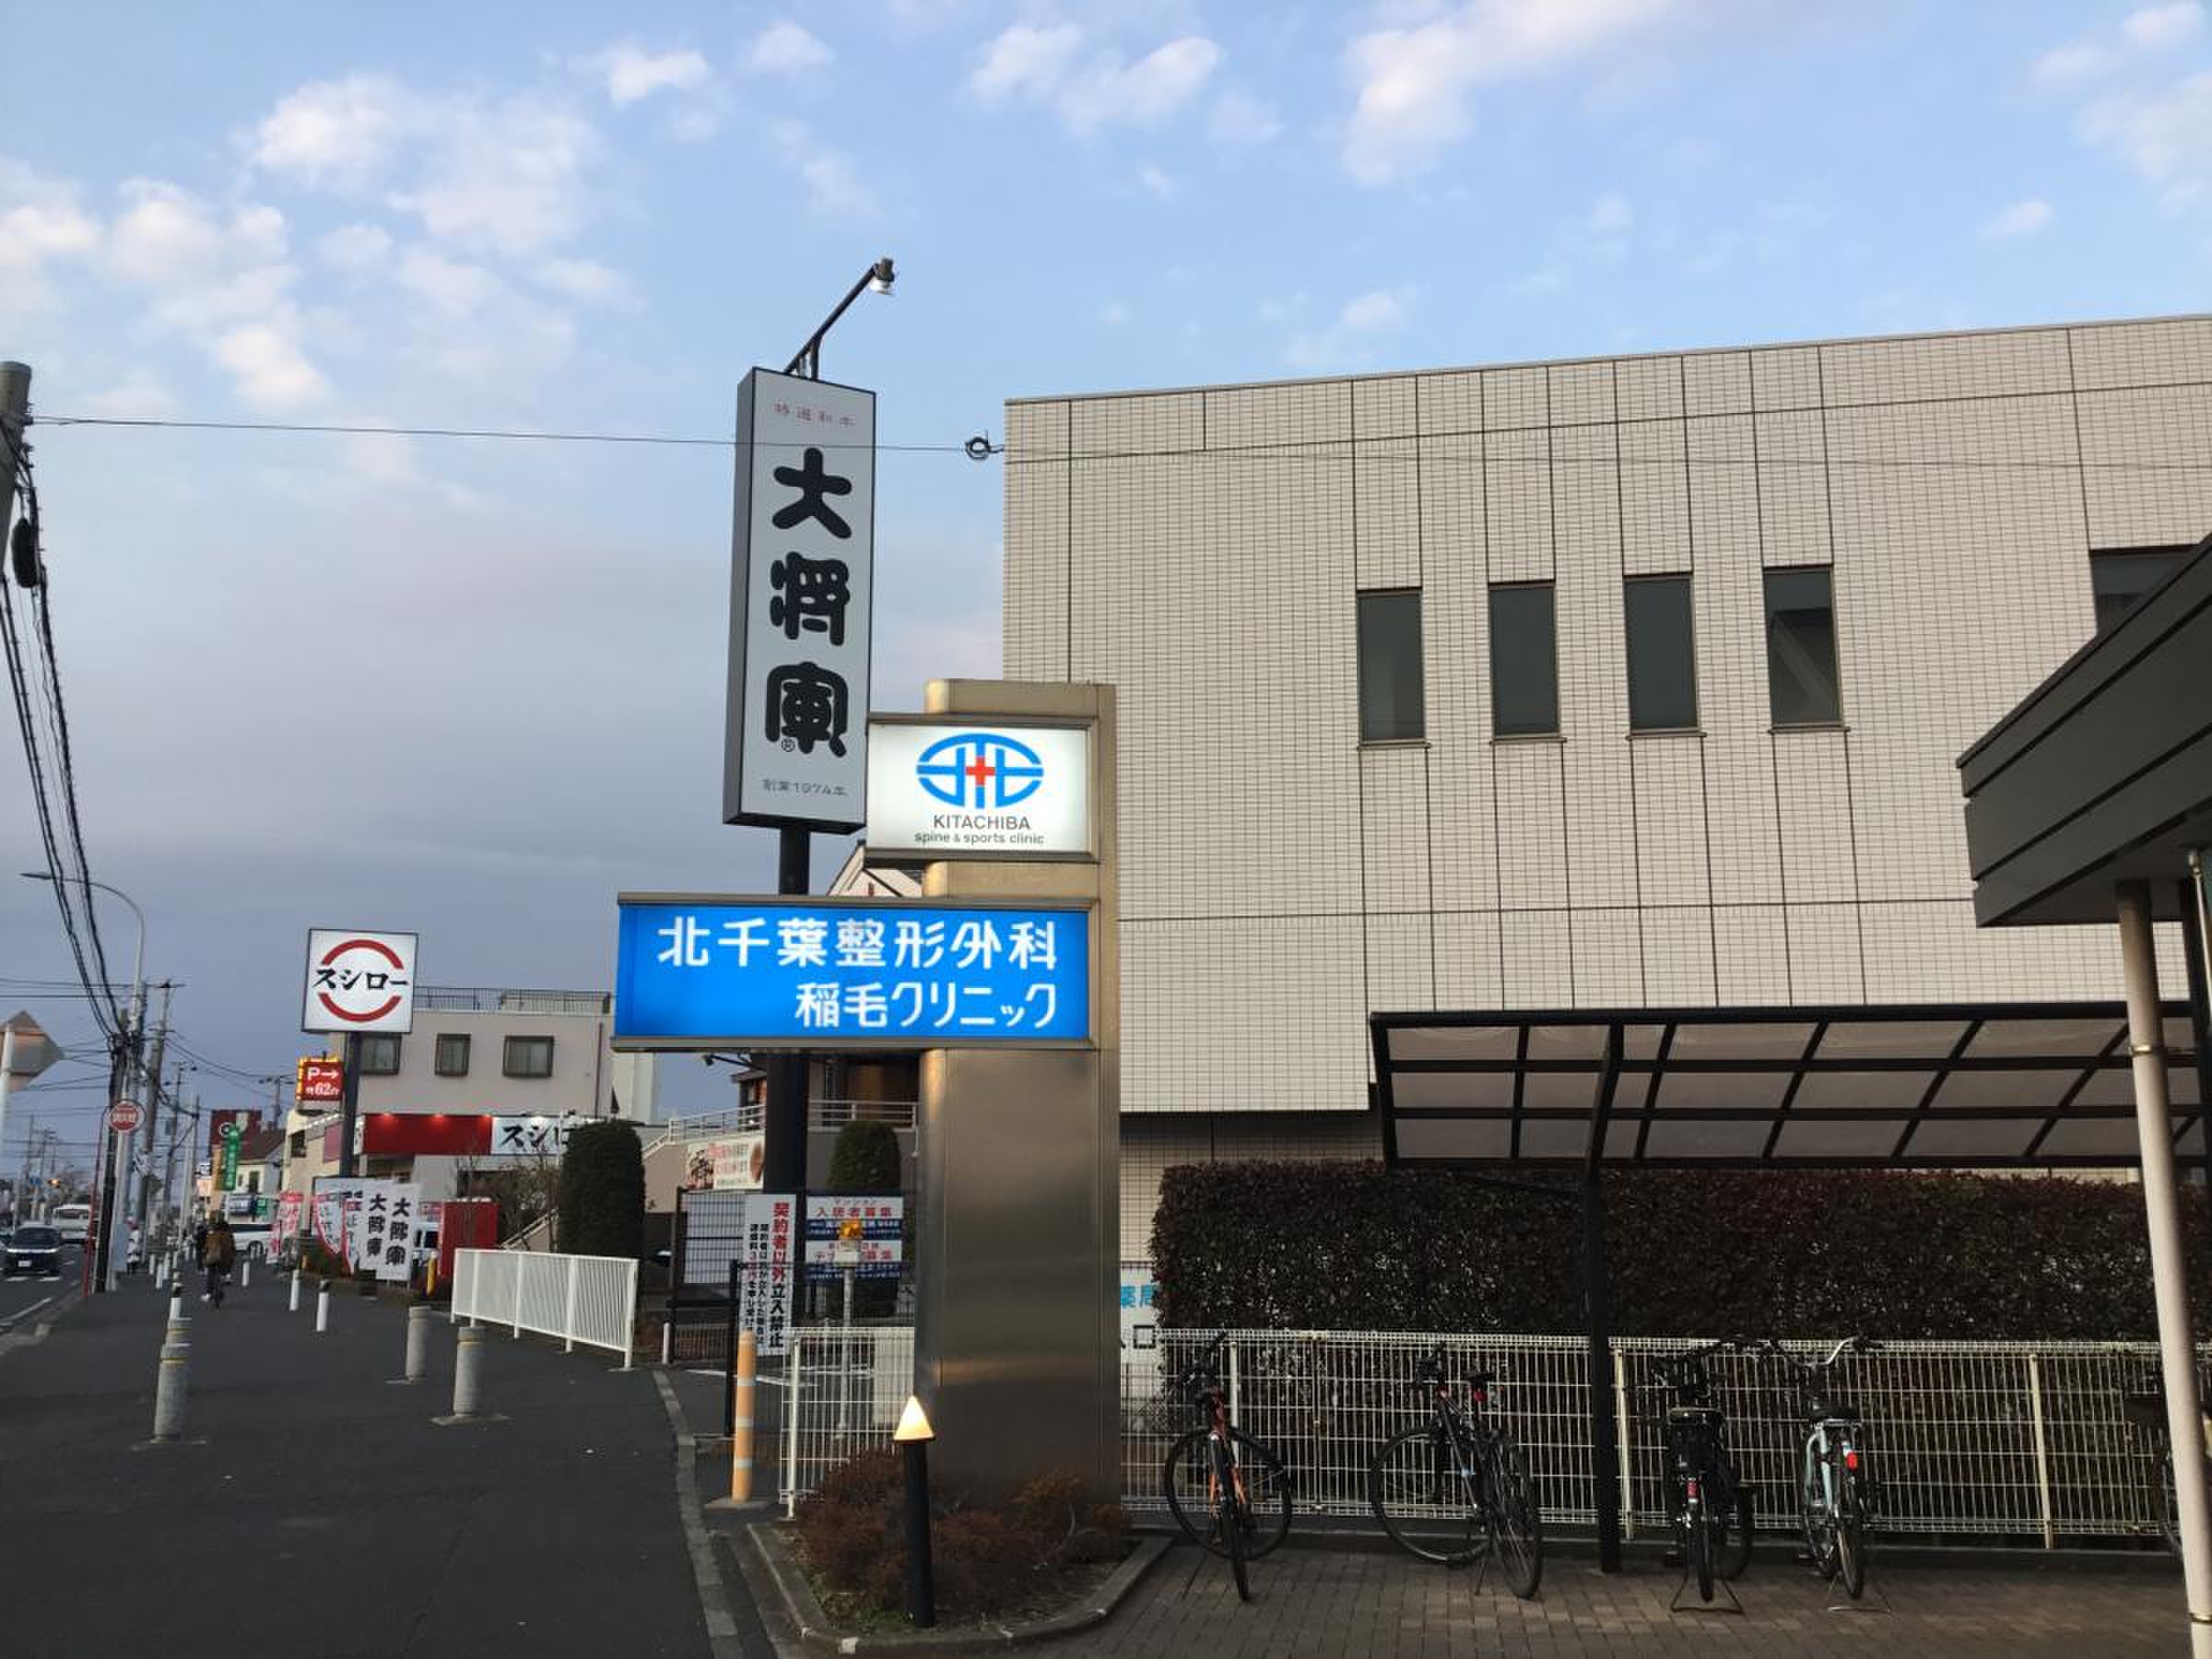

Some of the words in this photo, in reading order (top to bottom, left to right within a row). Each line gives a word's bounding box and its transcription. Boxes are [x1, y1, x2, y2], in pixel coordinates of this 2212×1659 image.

[765, 447, 853, 758] 大将軍
[913, 832, 950, 845] spine
[953, 833, 960, 842] &
[964, 833, 1005, 845] sports
[1009, 832, 1044, 844] clinic
[933, 814, 1030, 830] KITACHIBA
[657, 916, 1058, 970] 北千葉整形外科
[312, 968, 408, 991] スシロー
[794, 982, 1057, 1030] 稲毛クリニック
[307, 1066, 321, 1081] P
[769, 1201, 790, 1348] 契約者以外立入禁止
